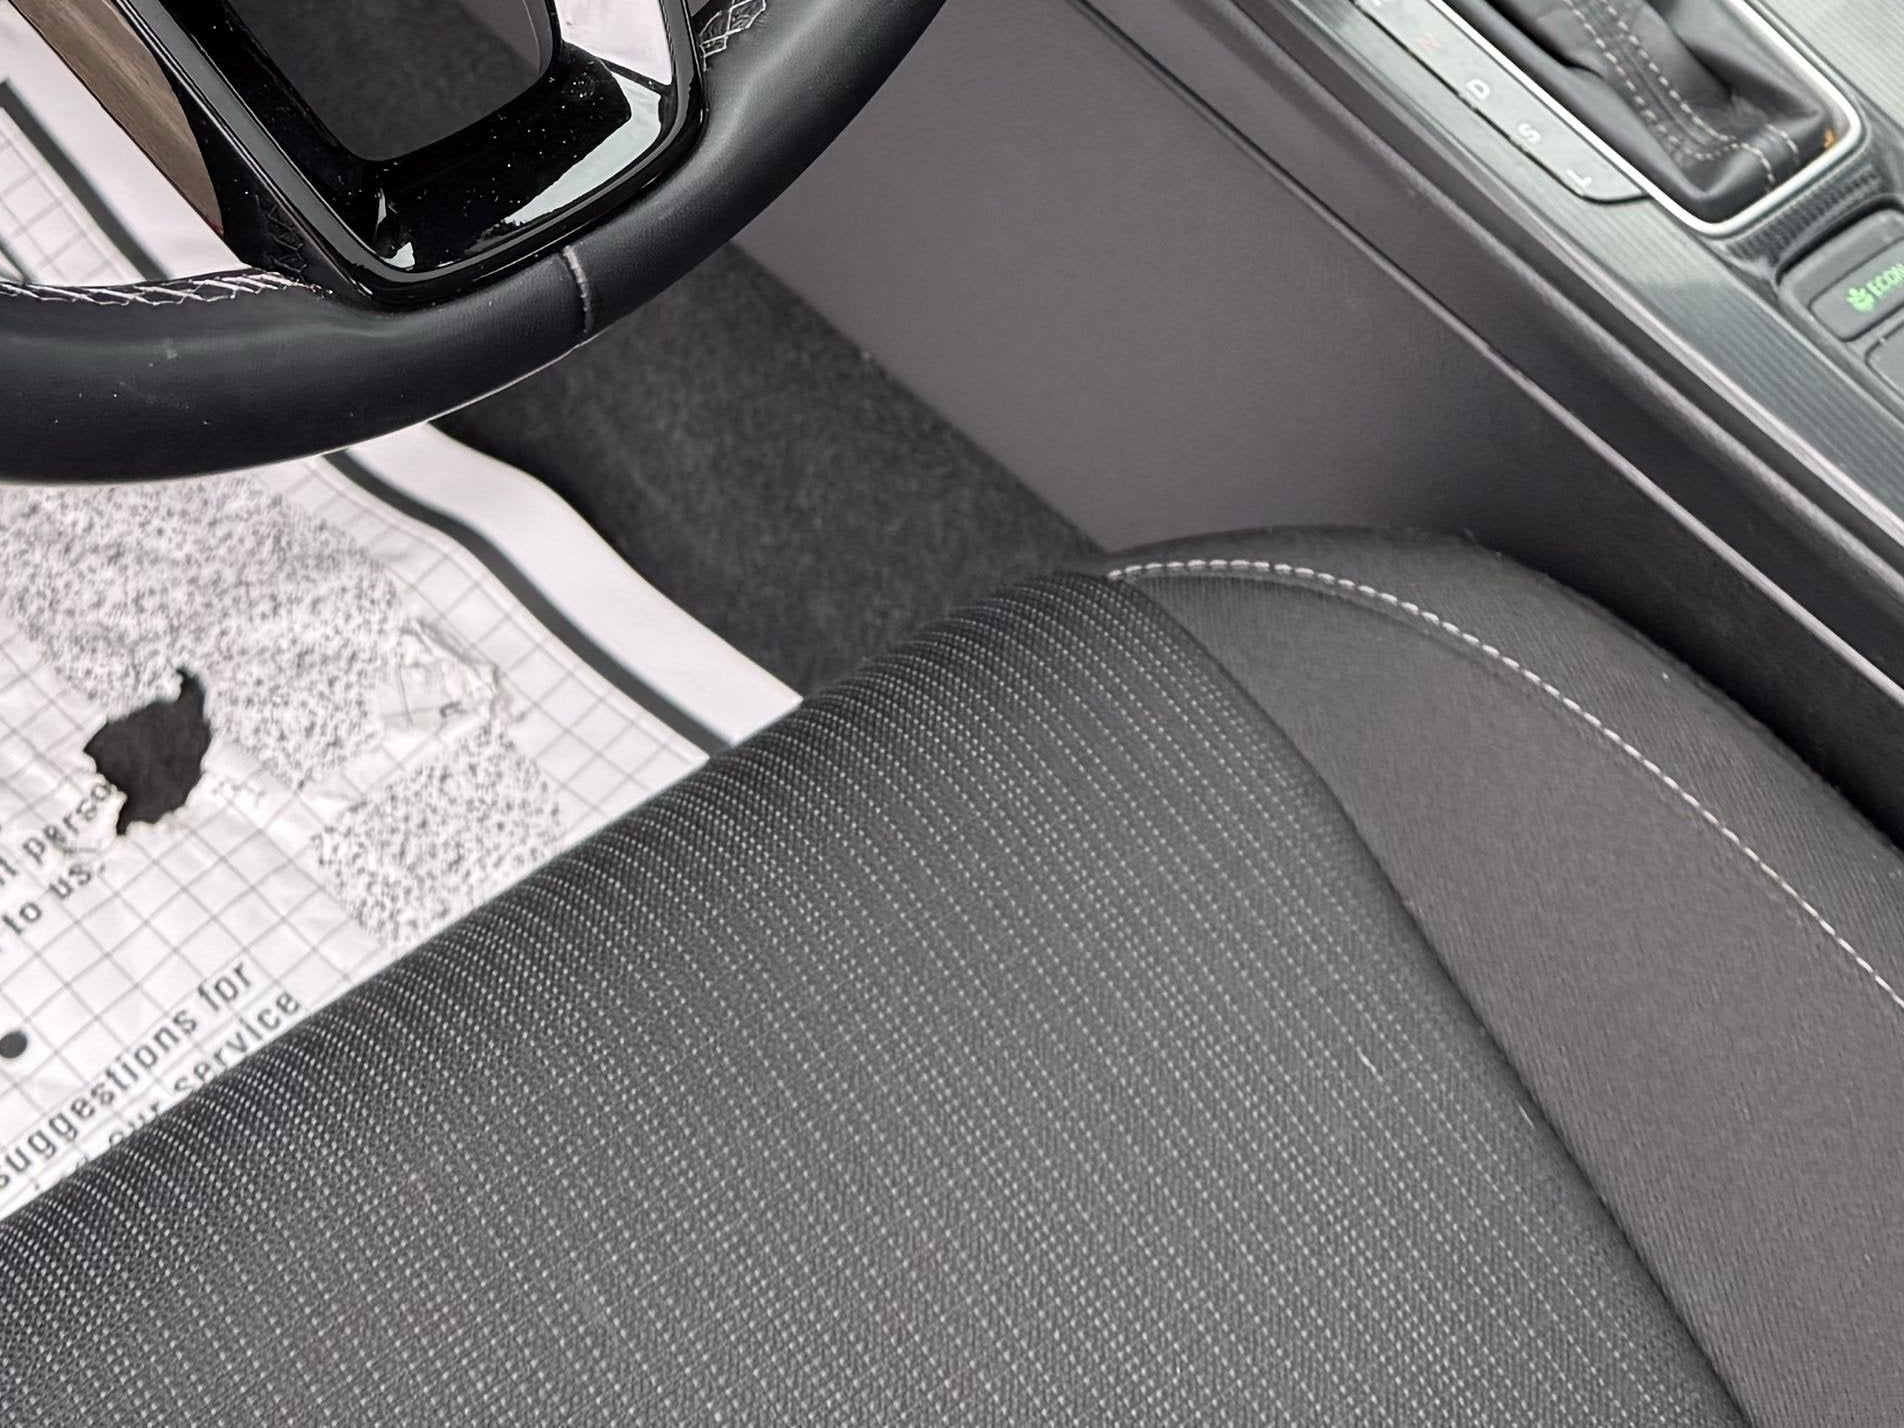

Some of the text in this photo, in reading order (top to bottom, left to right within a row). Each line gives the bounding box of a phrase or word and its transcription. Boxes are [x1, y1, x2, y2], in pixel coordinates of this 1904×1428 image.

[1466, 78, 1491, 101] D
[1517, 122, 1542, 144] S
[1565, 167, 1593, 189] L
[1, 896, 44, 938] to
[197, 958, 255, 1015] for
[172, 987, 302, 1097] service
